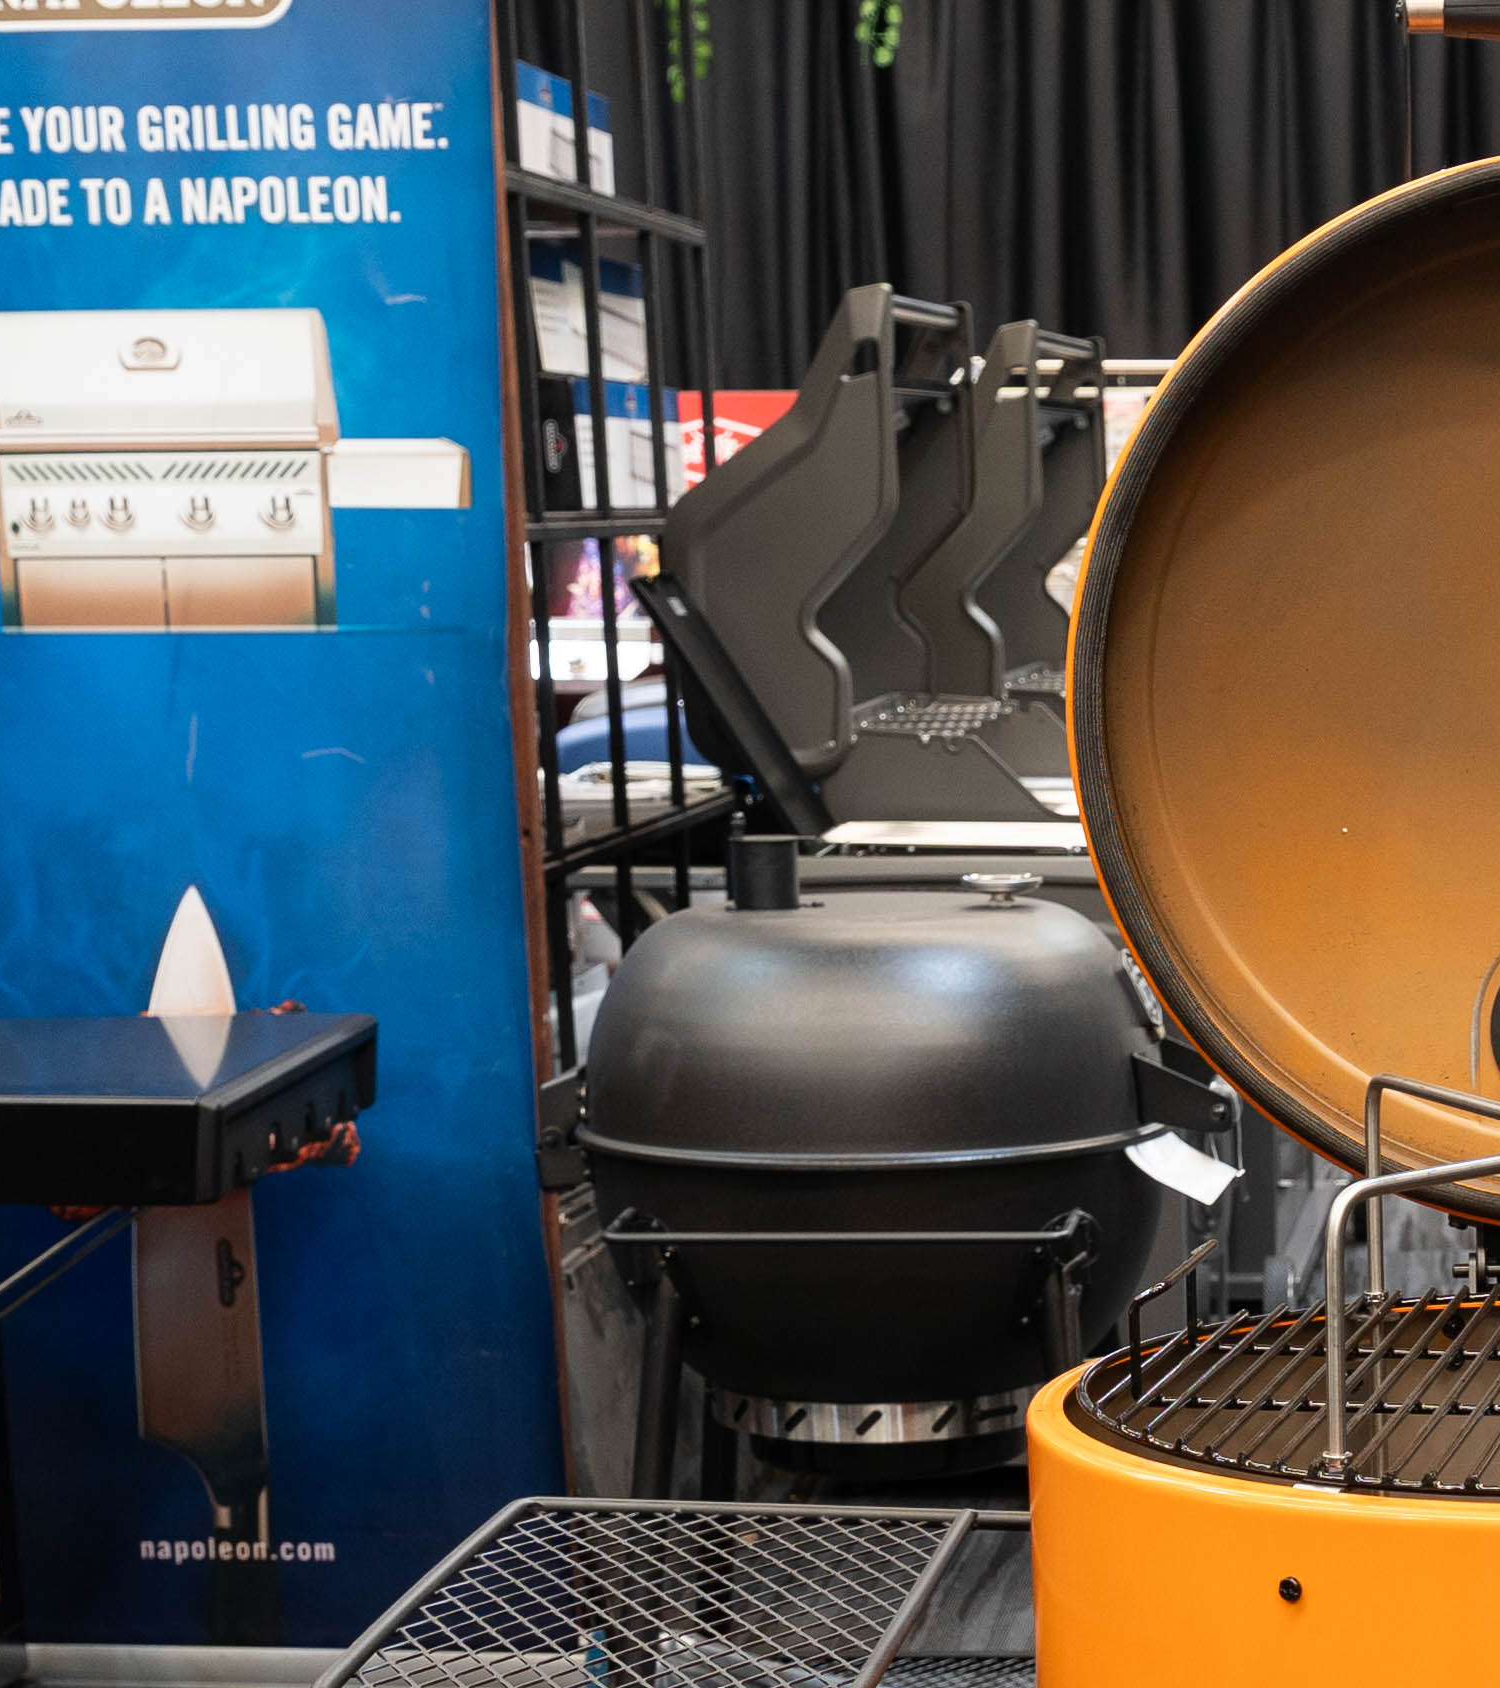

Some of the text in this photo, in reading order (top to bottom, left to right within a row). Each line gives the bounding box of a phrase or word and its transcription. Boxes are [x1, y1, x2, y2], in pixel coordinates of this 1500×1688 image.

[20, 104, 128, 153] YOUR
[137, 103, 315, 152] GRILLING
[328, 101, 448, 151] GAME.
[80, 178, 132, 226] TO
[143, 178, 171, 226] A
[181, 176, 401, 225] NAPOLEON.
[140, 1536, 336, 1565] napoleon.com
